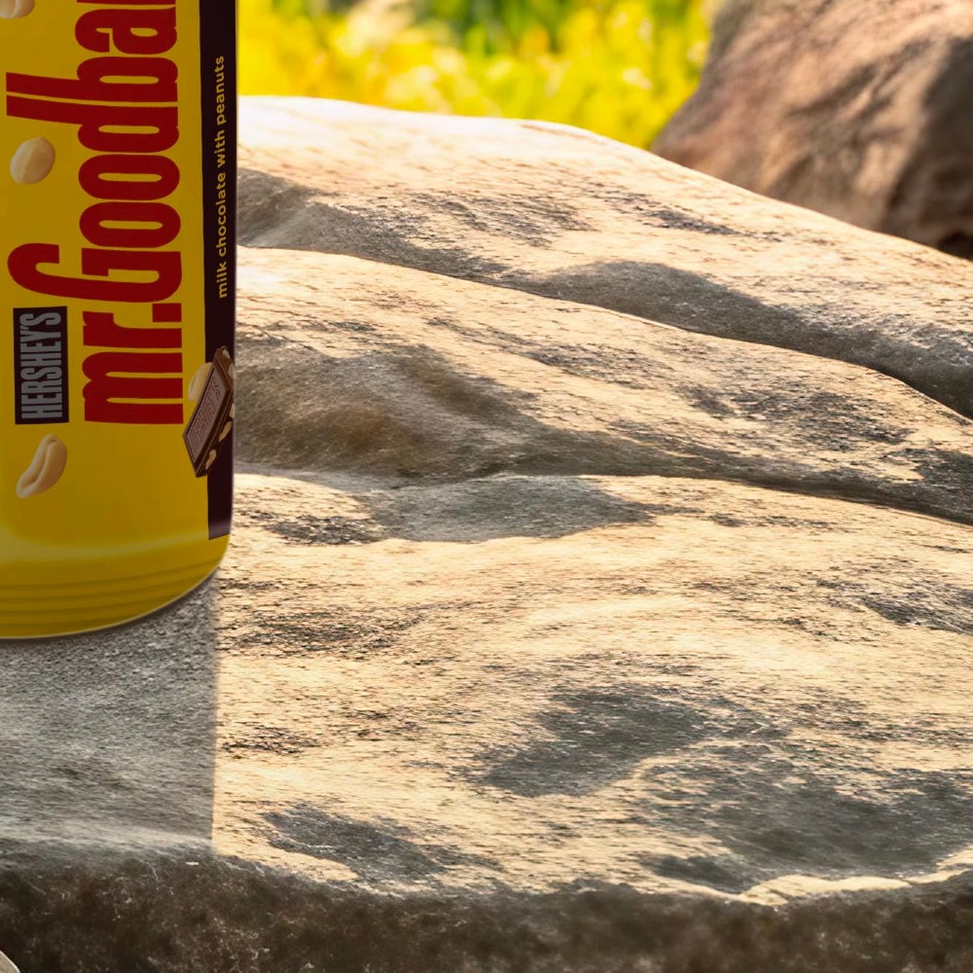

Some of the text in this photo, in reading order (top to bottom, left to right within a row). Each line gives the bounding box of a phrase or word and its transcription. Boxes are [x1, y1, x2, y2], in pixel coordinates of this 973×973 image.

[212, 56, 228, 298] milk chocolate with peanuts
[17, 312, 63, 419] HERSHEY'S
